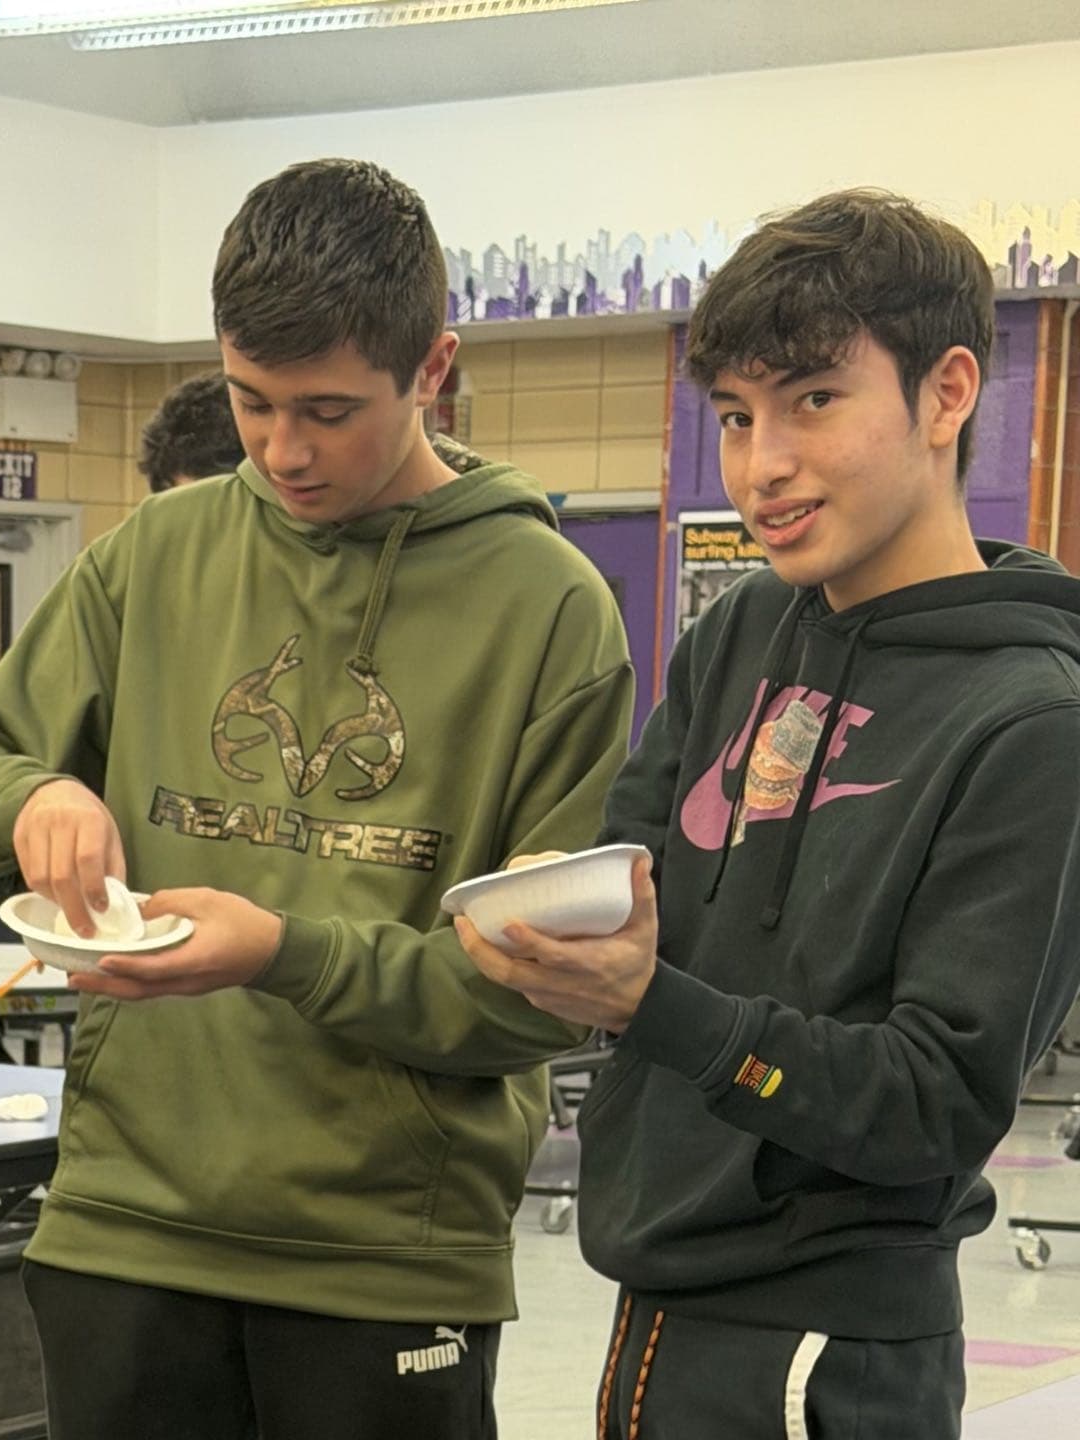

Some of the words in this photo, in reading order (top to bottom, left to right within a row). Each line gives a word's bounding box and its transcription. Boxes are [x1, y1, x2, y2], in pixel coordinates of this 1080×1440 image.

[685, 528, 741, 545] Subway
[148, 785, 442, 871] REALTREE
[396, 1341, 461, 1376] PUMA
